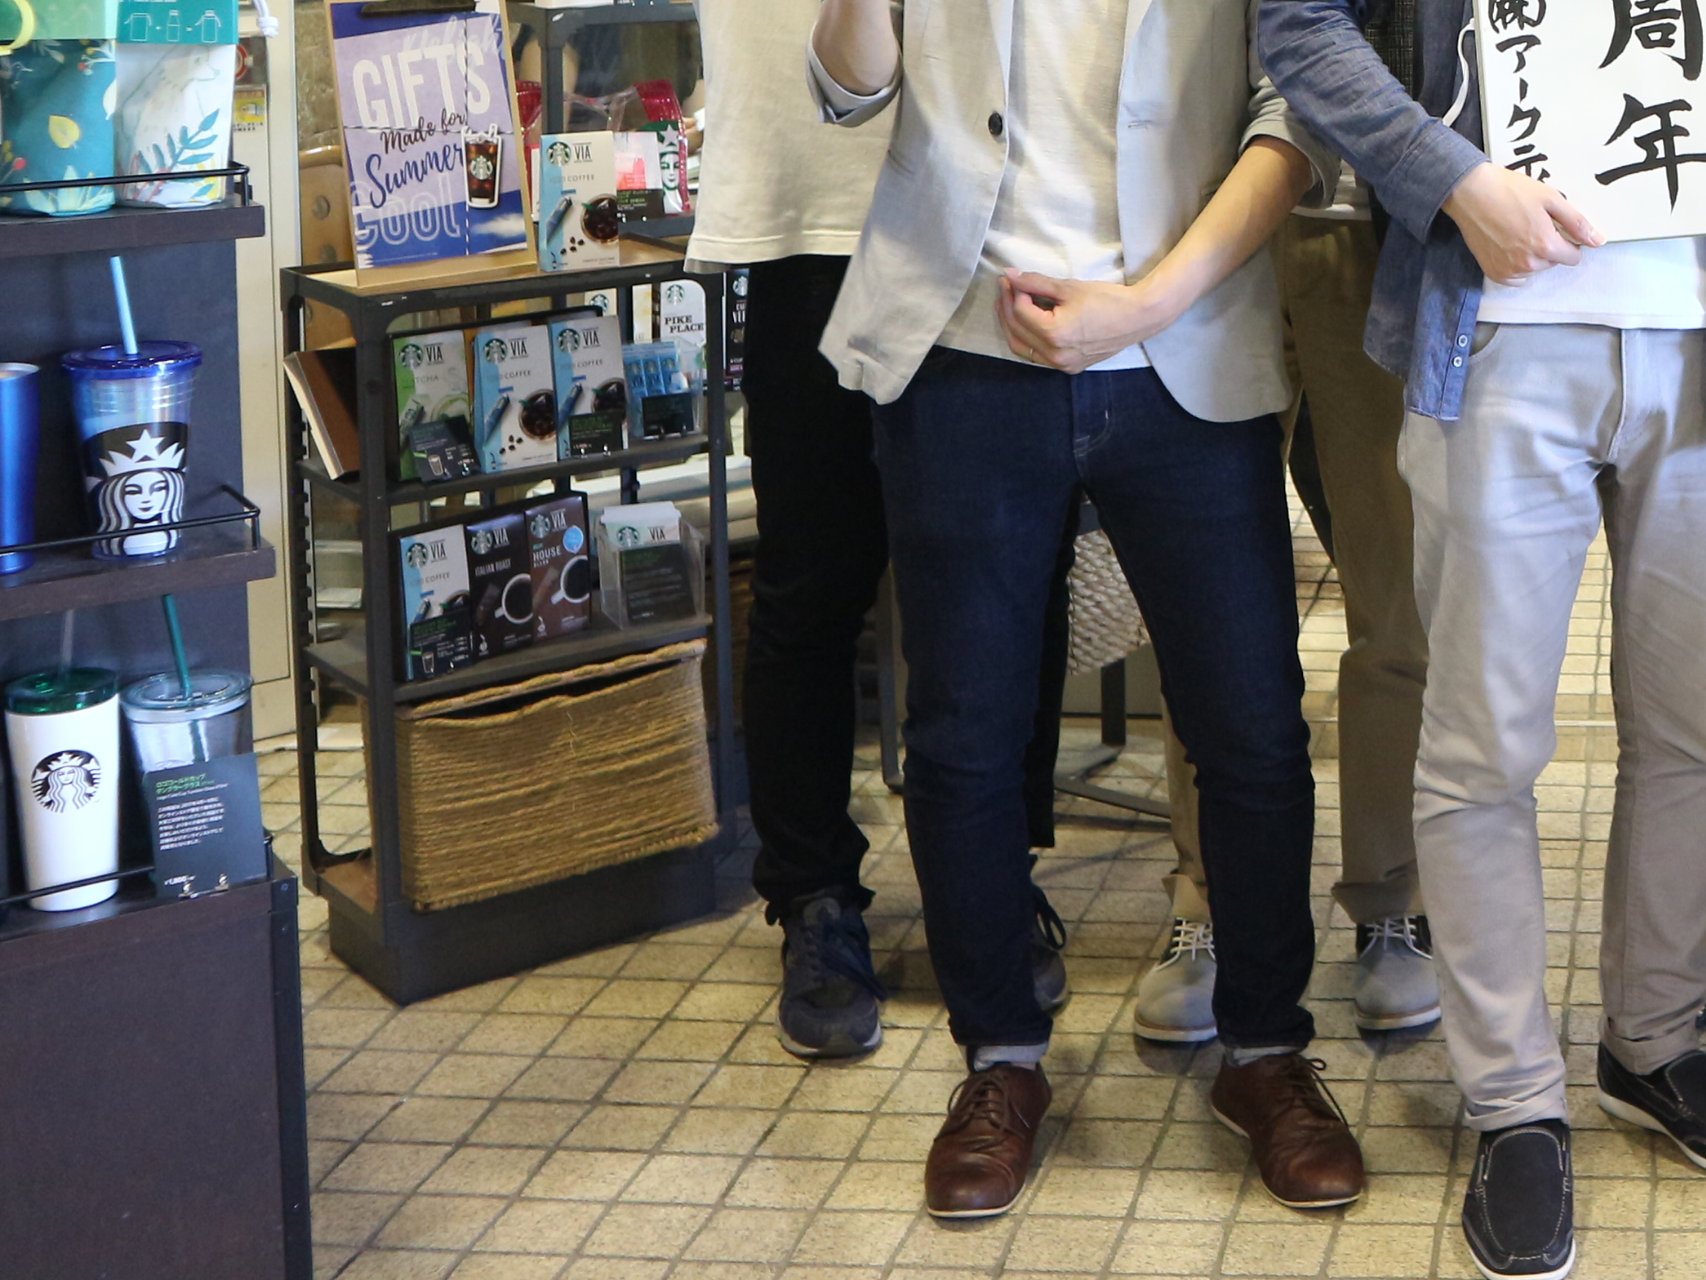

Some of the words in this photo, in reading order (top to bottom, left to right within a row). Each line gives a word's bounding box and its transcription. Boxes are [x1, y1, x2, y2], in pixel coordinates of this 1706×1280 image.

[353, 41, 491, 132] GIFTS
[380, 116, 436, 155] Made
[440, 107, 466, 136] for
[573, 144, 591, 160] VIA
[365, 143, 463, 209] Summer
[664, 315, 693, 325] PIKE
[669, 322, 705, 334] PLACE
[583, 330, 600, 346] VIA
[426, 345, 443, 361] VIA
[510, 340, 527, 356] VIA
[551, 508, 566, 528] VIA
[493, 527, 509, 544] VIA
[649, 526, 666, 541] VIA
[430, 542, 447, 559] VIA
[532, 545, 561, 562] HOUSE
